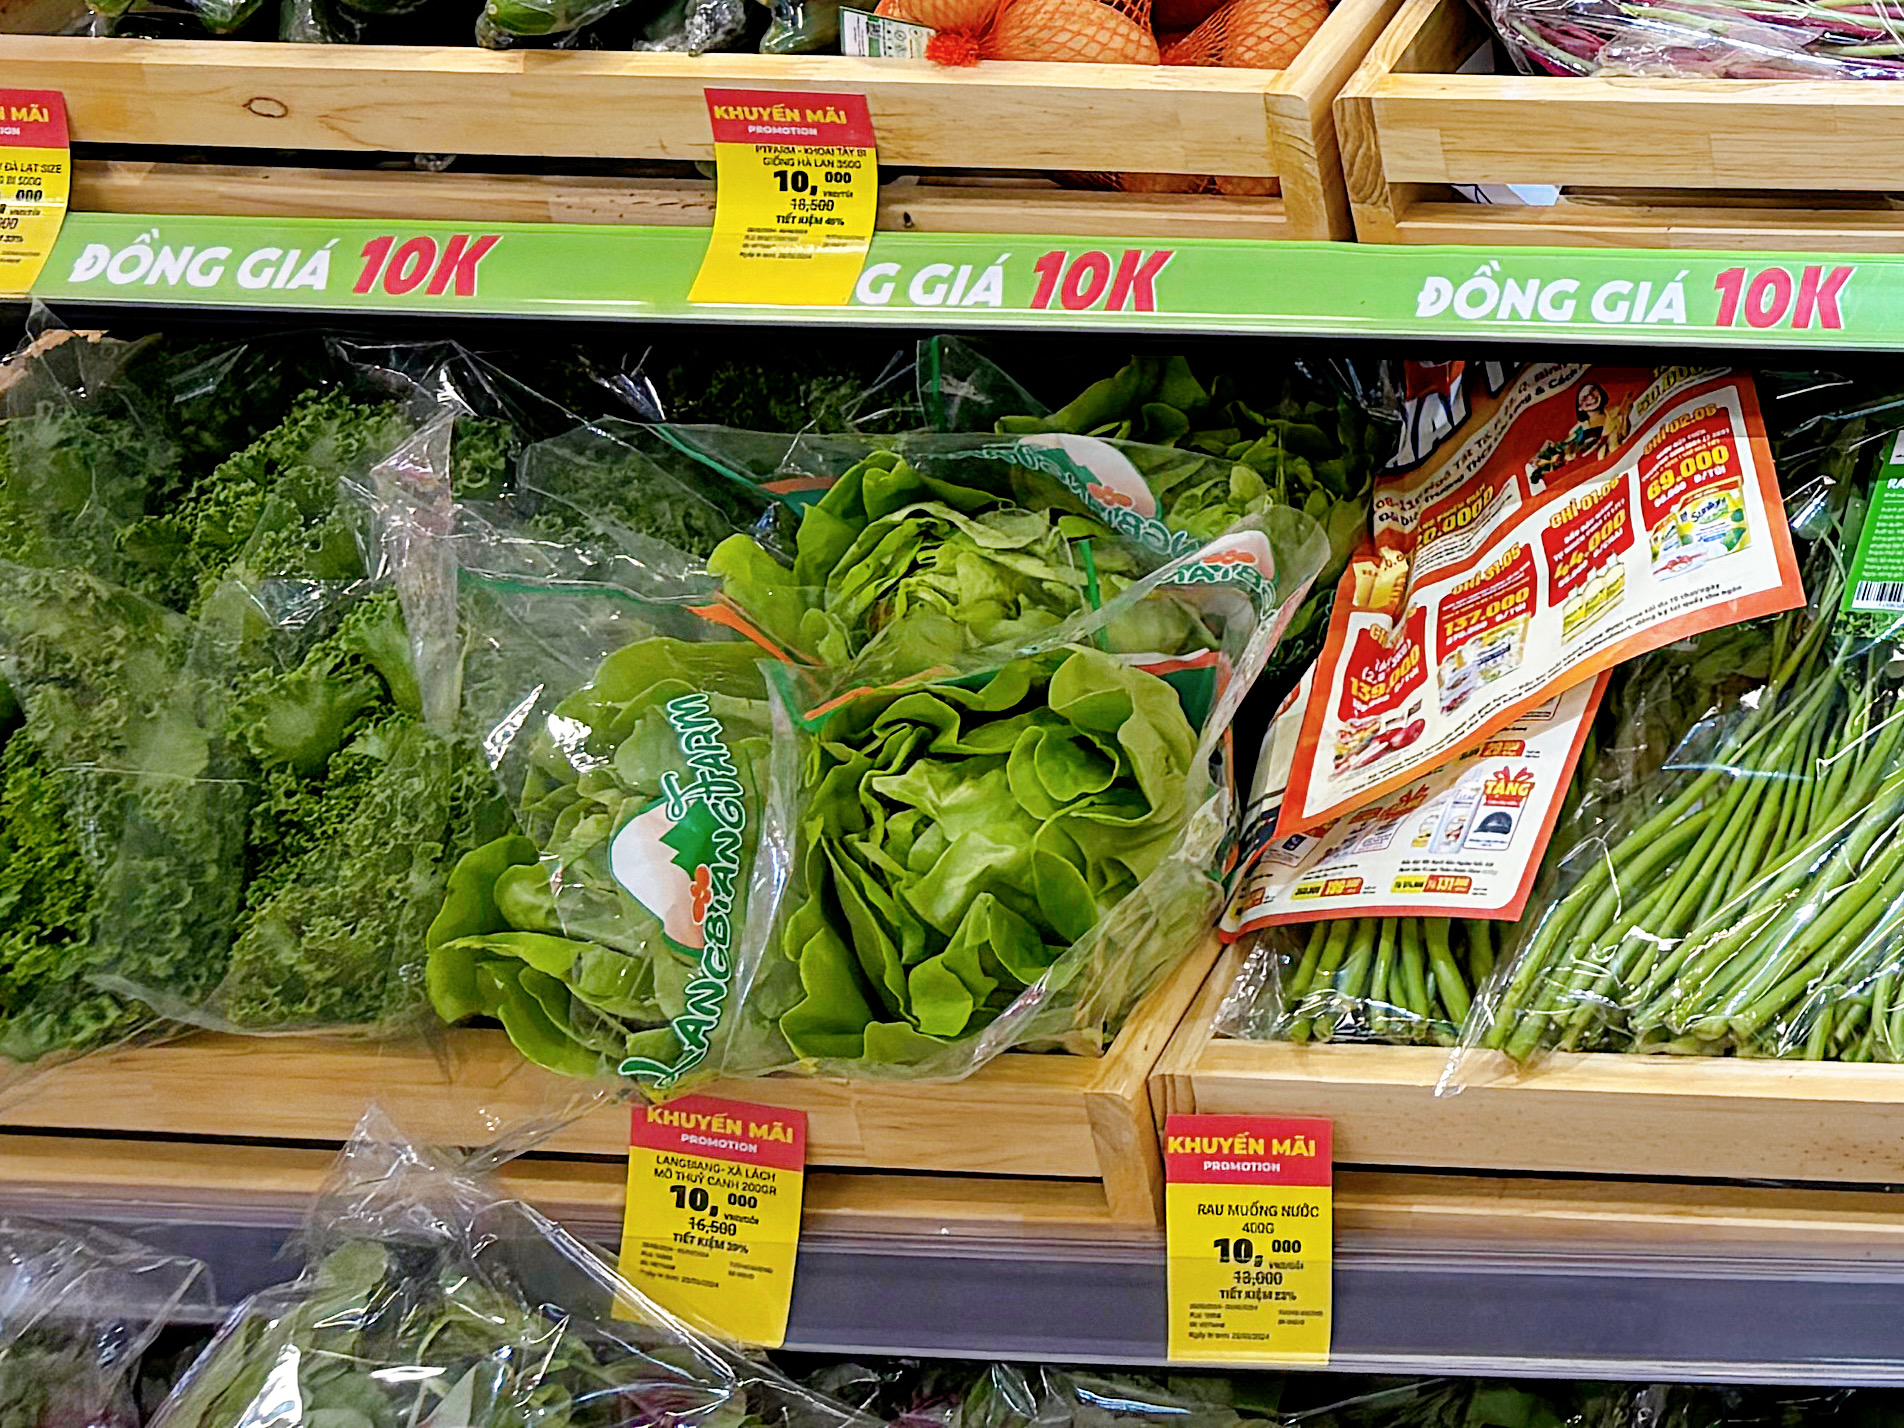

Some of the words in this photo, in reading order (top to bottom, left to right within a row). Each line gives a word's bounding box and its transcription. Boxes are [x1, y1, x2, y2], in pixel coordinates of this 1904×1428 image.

[68, 224, 236, 291] ĐỒNG
[251, 235, 337, 295] GIÁ
[349, 234, 506, 298] 10K
[906, 251, 1006, 309] GIÁ
[1028, 249, 1182, 312] 10K
[1415, 256, 1580, 325] ĐỒNG
[1590, 270, 1688, 327] GIÁ
[1713, 264, 1859, 330] 10K
